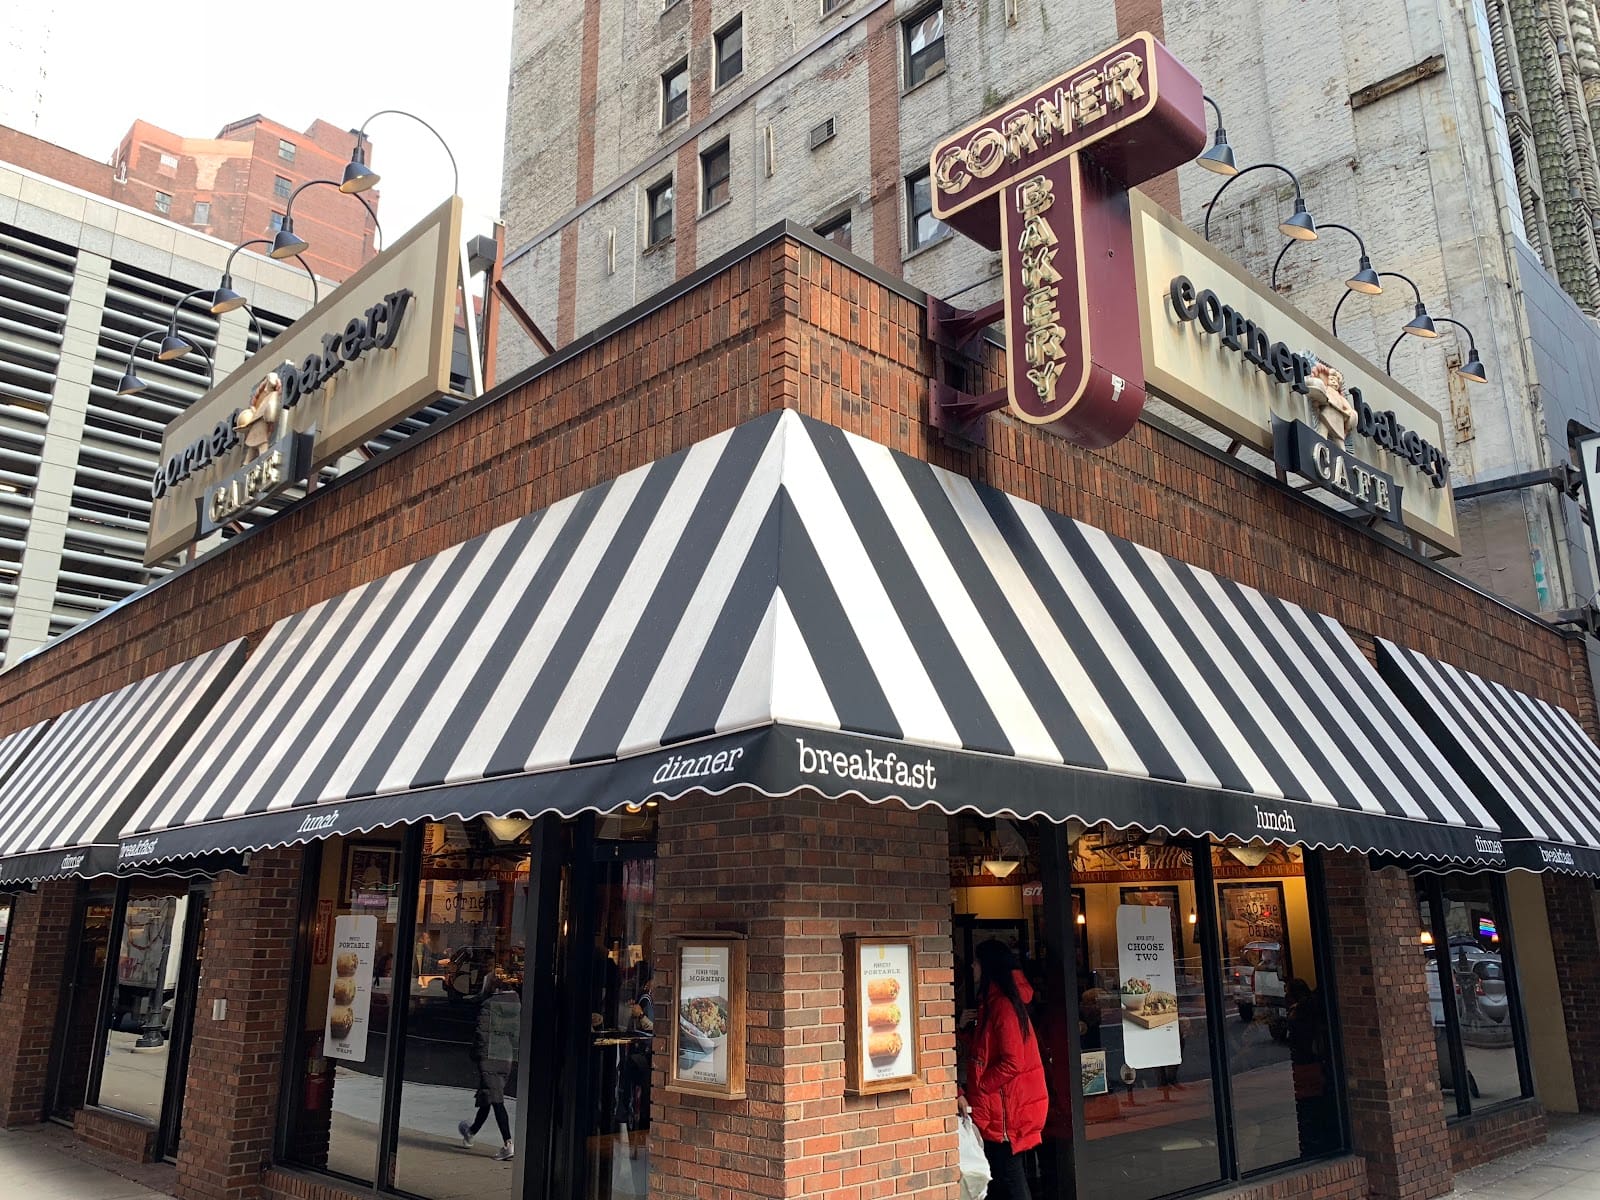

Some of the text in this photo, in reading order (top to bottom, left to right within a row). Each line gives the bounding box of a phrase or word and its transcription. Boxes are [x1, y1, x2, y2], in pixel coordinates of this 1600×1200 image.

[936, 51, 1146, 195] CORNER
[1015, 174, 1068, 403] BAKERY
[151, 287, 415, 500] corner bakery
[1170, 274, 1450, 489] corner bakery
[208, 449, 282, 524] CAFE
[1312, 441, 1391, 513] CAFE
[651, 746, 744, 785] dinner
[795, 738, 937, 790] breakfast
[297, 809, 339, 834] lunch
[1254, 805, 1296, 834] lunch
[119, 837, 159, 859] breakfast
[1475, 835, 1503, 855] dinner
[1127, 942, 1165, 951] CHOOSE
[1135, 953, 1159, 961] TWO
[689, 975, 726, 983] MORNING
